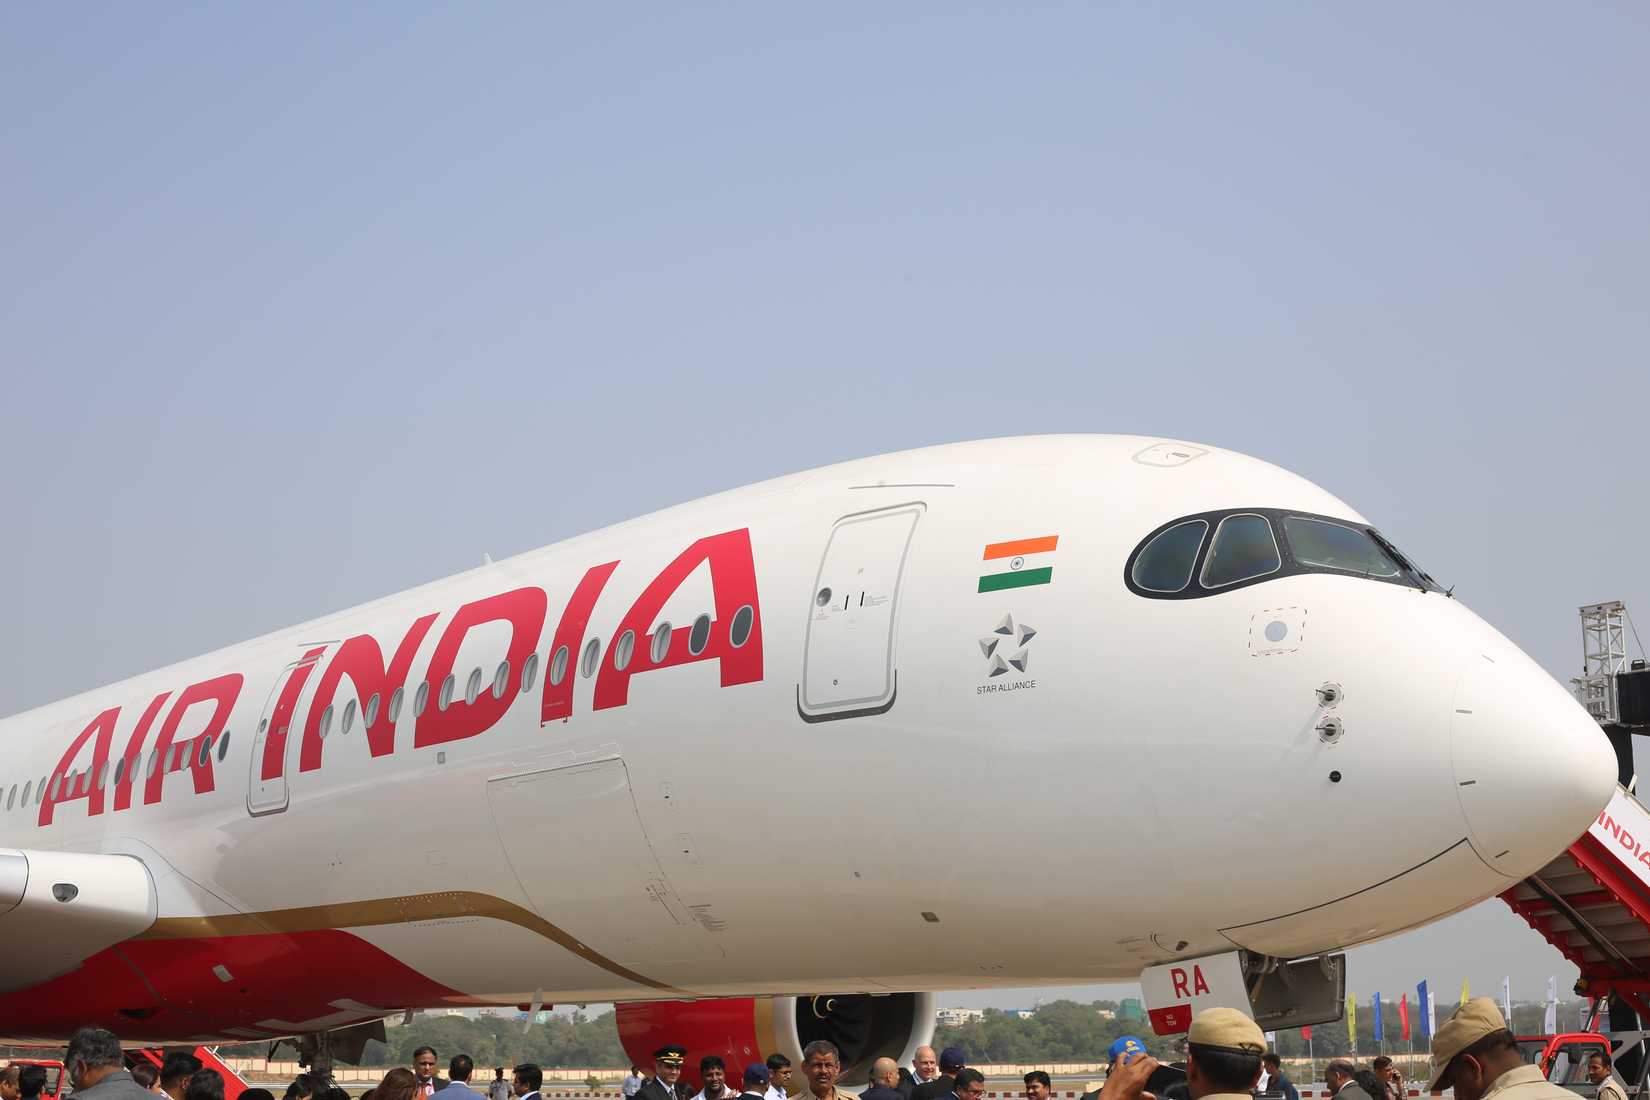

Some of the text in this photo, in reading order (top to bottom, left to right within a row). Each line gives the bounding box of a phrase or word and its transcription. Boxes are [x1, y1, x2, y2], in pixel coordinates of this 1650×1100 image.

[39, 528, 764, 827] AIR INDIA
[977, 680, 1037, 695] STAR ALLIANCE
[1170, 964, 1210, 999] RA
